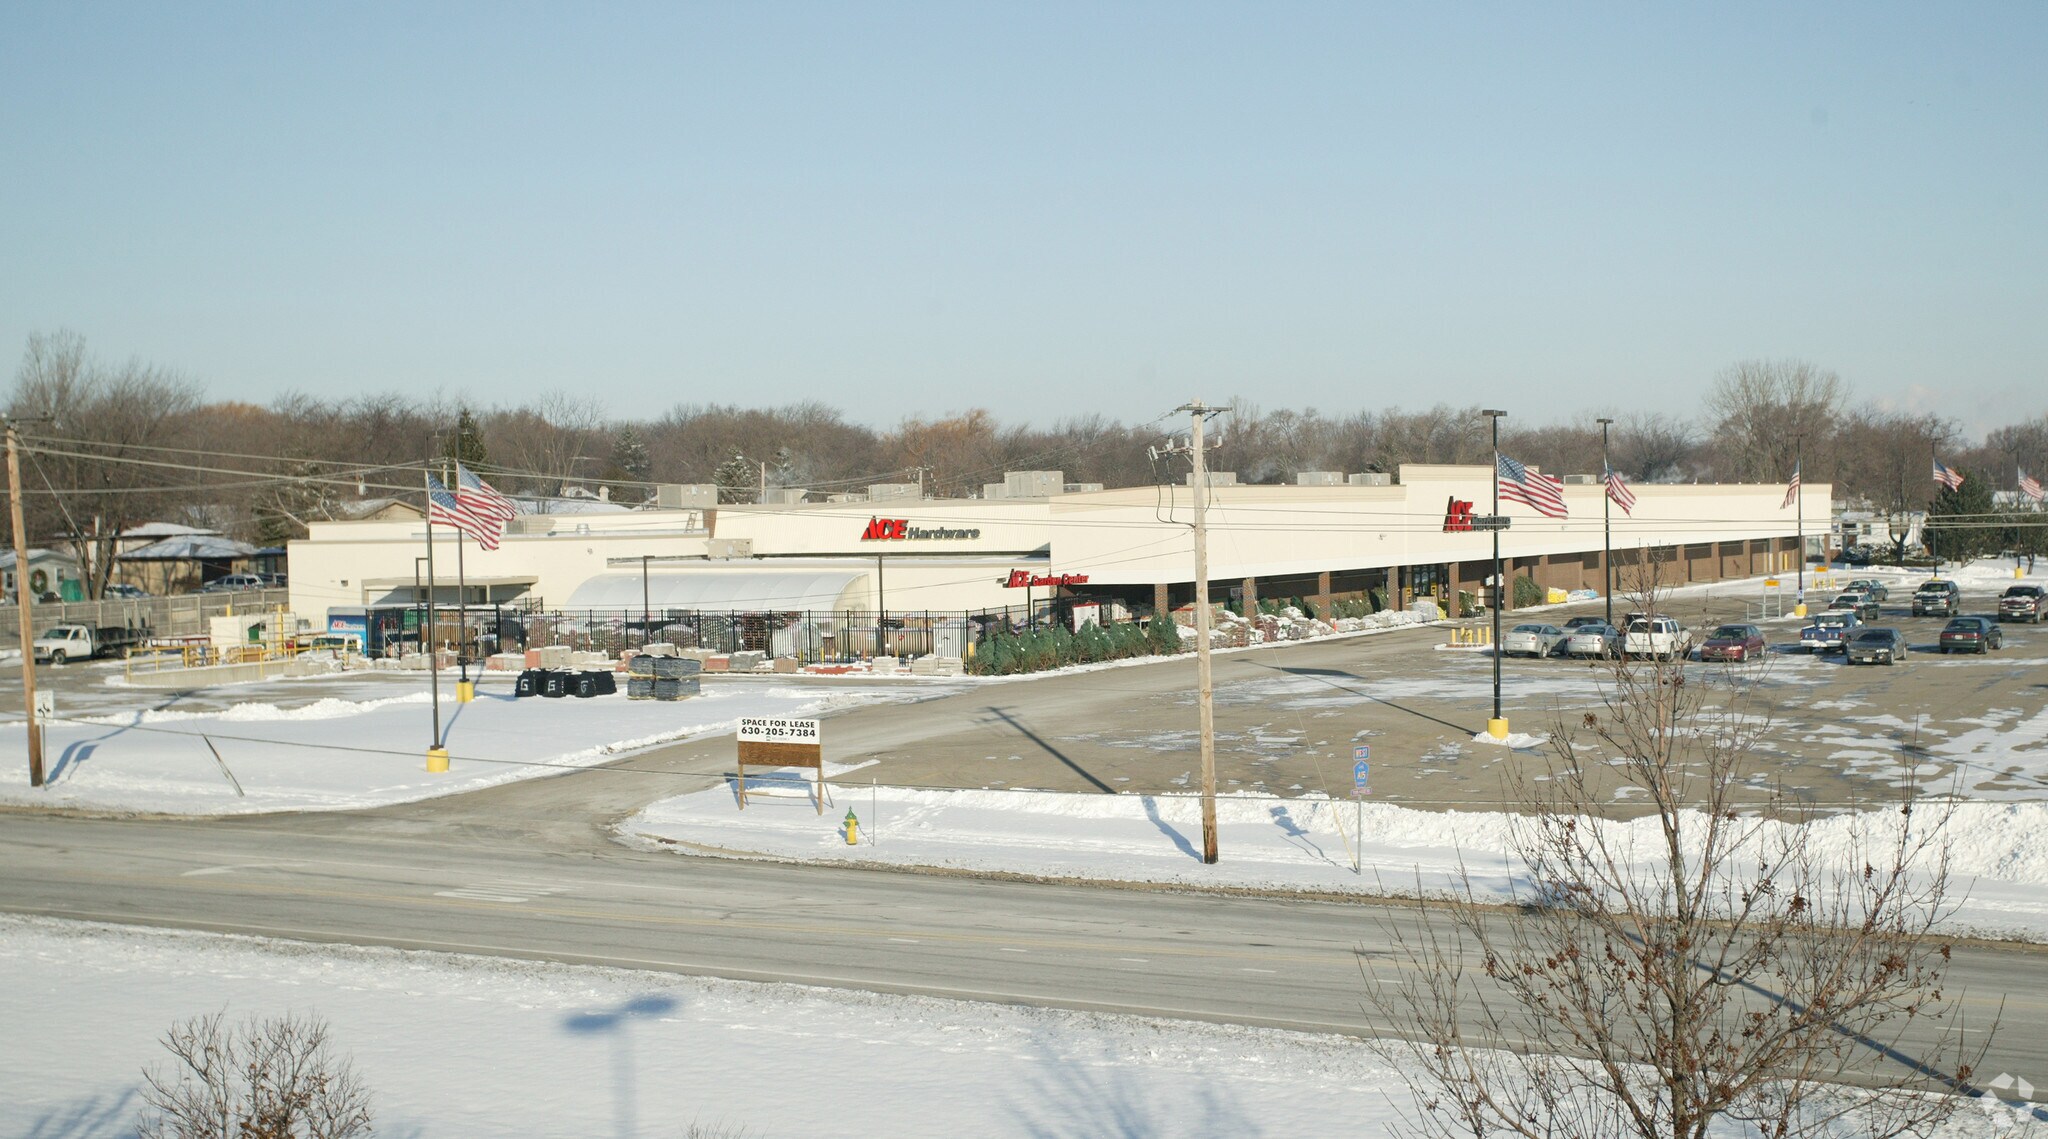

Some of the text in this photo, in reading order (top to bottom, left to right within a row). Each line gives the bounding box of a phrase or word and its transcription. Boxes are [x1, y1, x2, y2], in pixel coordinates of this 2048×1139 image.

[1443, 496, 1473, 533] ACE
[861, 516, 981, 540] ACE Hardware
[1008, 569, 1089, 588] ACE Garden Center
[741, 718, 815, 729] SPACE FOR LEASE
[741, 726, 816, 738] 630-205-7384
